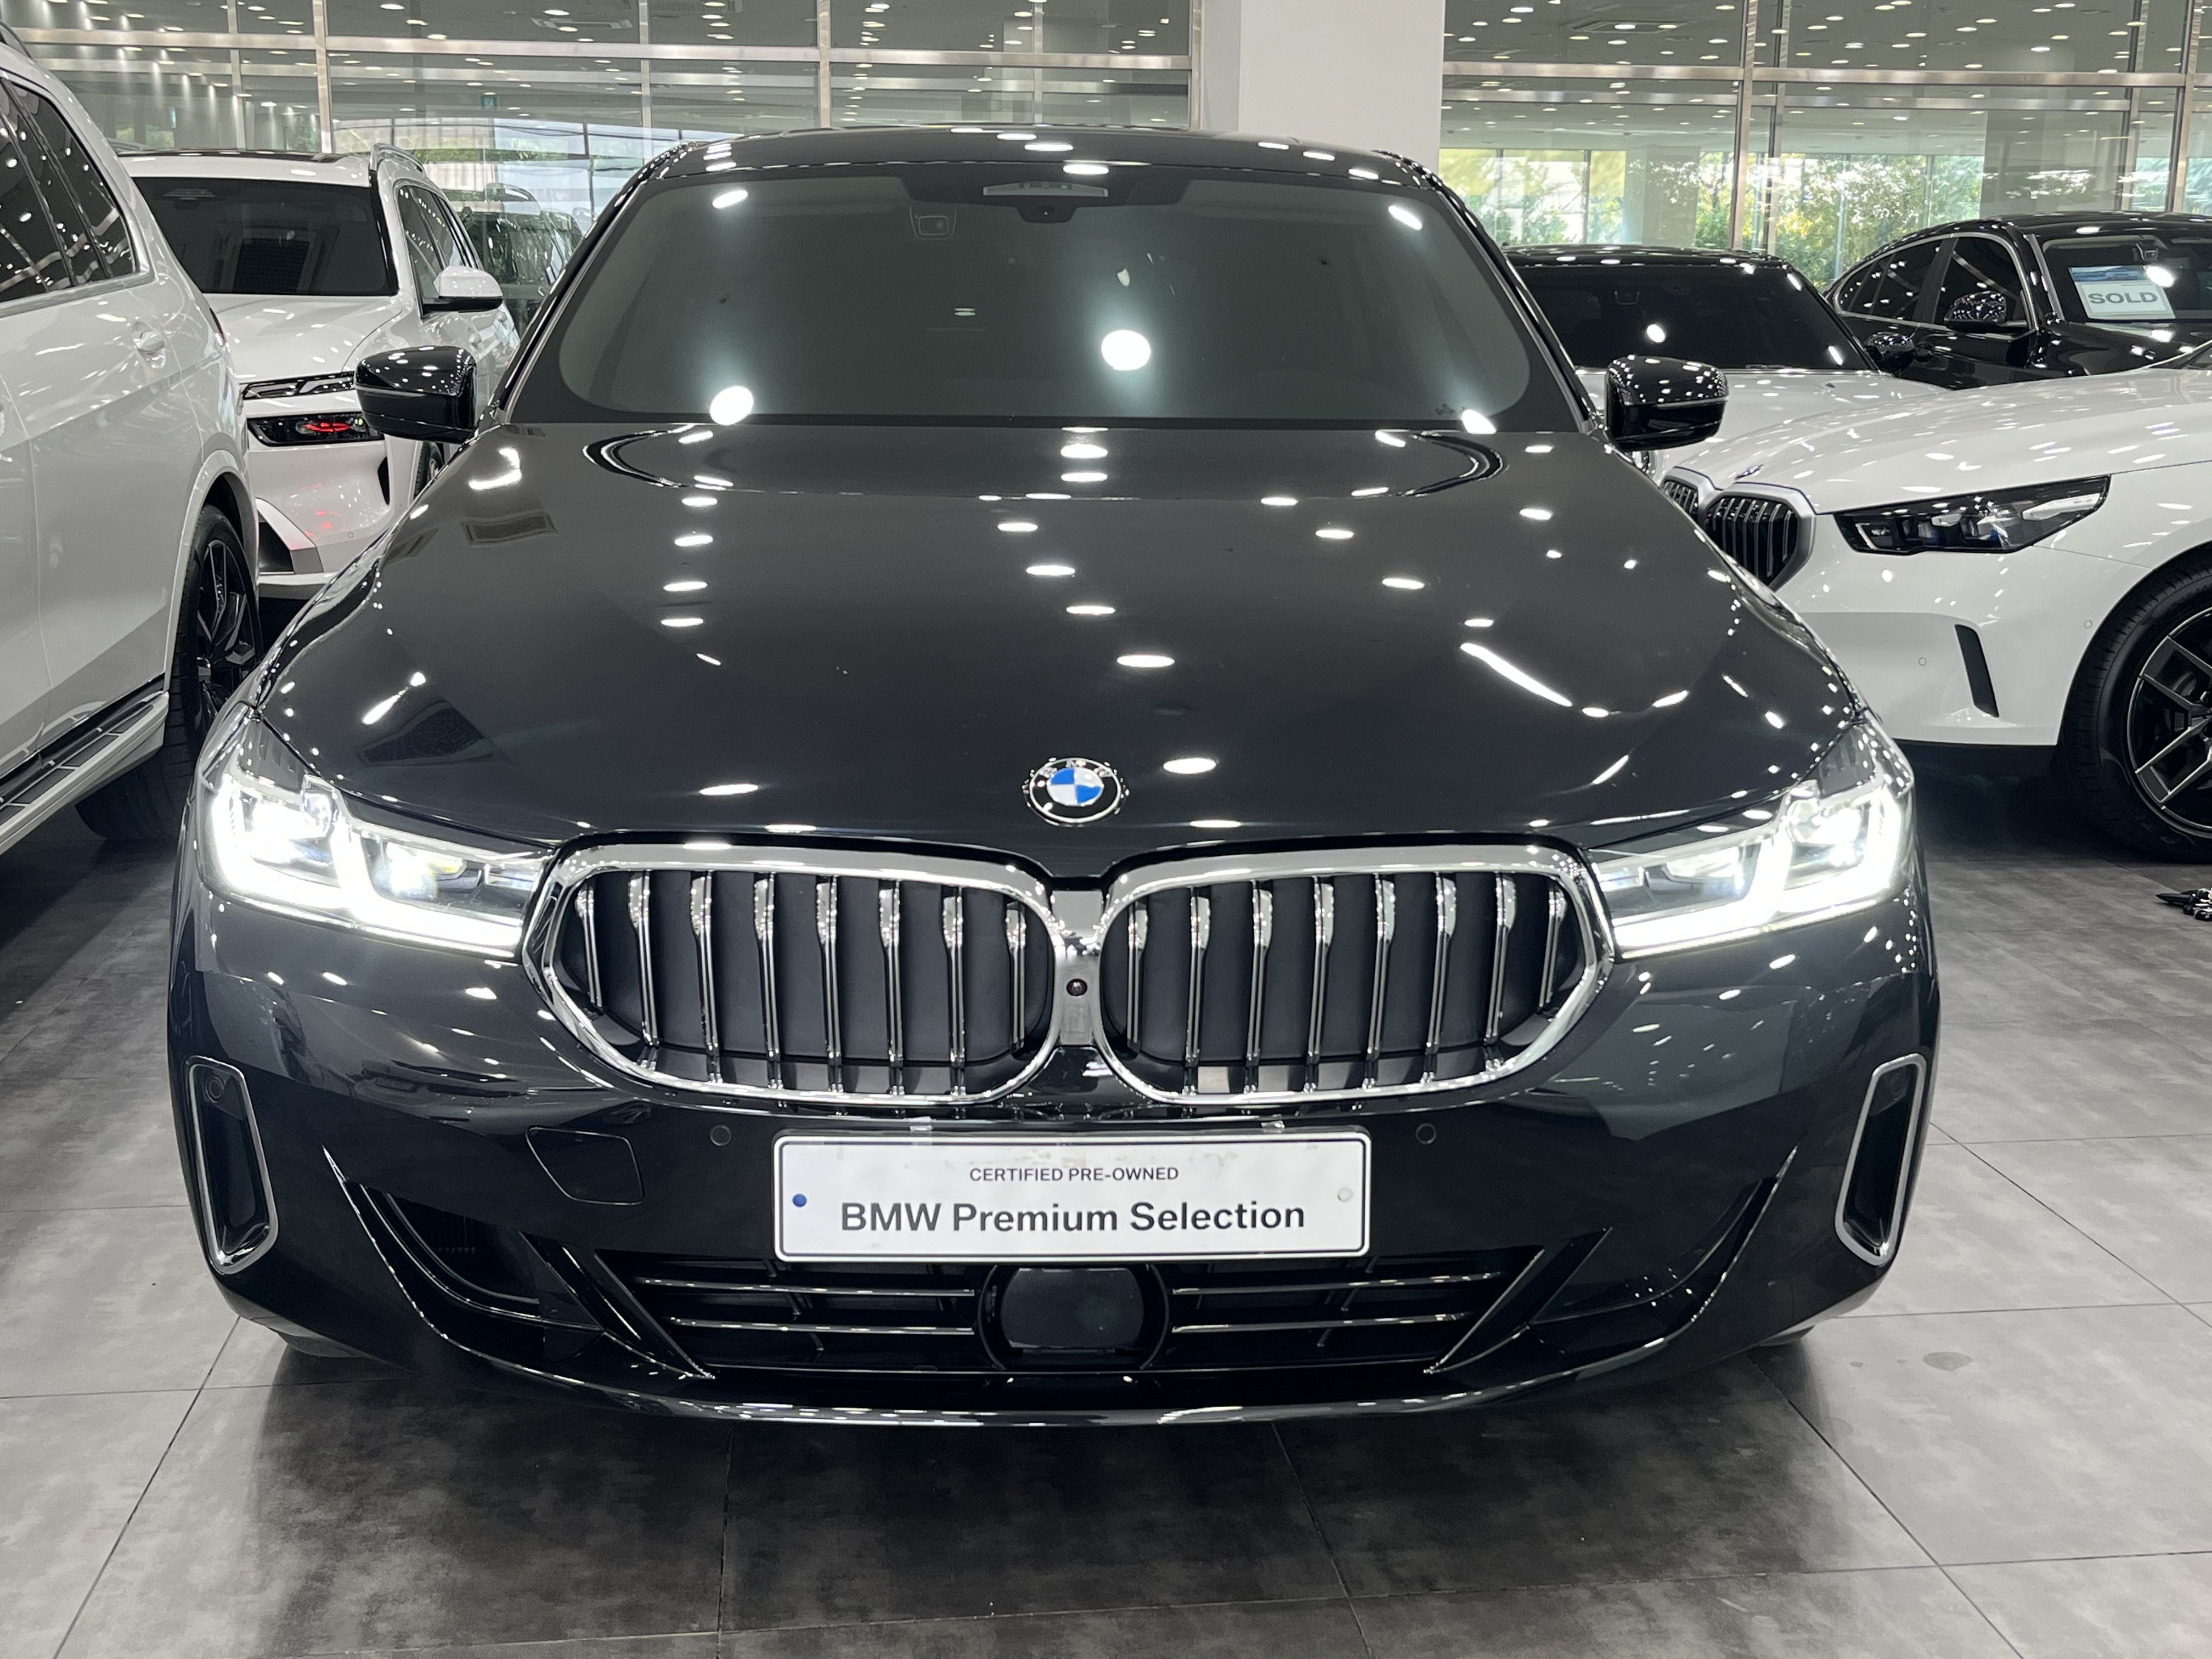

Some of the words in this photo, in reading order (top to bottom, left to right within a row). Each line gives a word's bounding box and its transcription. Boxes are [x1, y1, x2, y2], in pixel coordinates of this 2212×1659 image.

[2088, 292, 2157, 304] SOLD
[969, 1168, 1063, 1181] CERTIFIED
[1069, 1167, 1179, 1181] PRE-OWNED
[842, 1203, 941, 1232] BMW
[953, 1203, 1118, 1232] Premium
[1130, 1200, 1305, 1231] Selection
